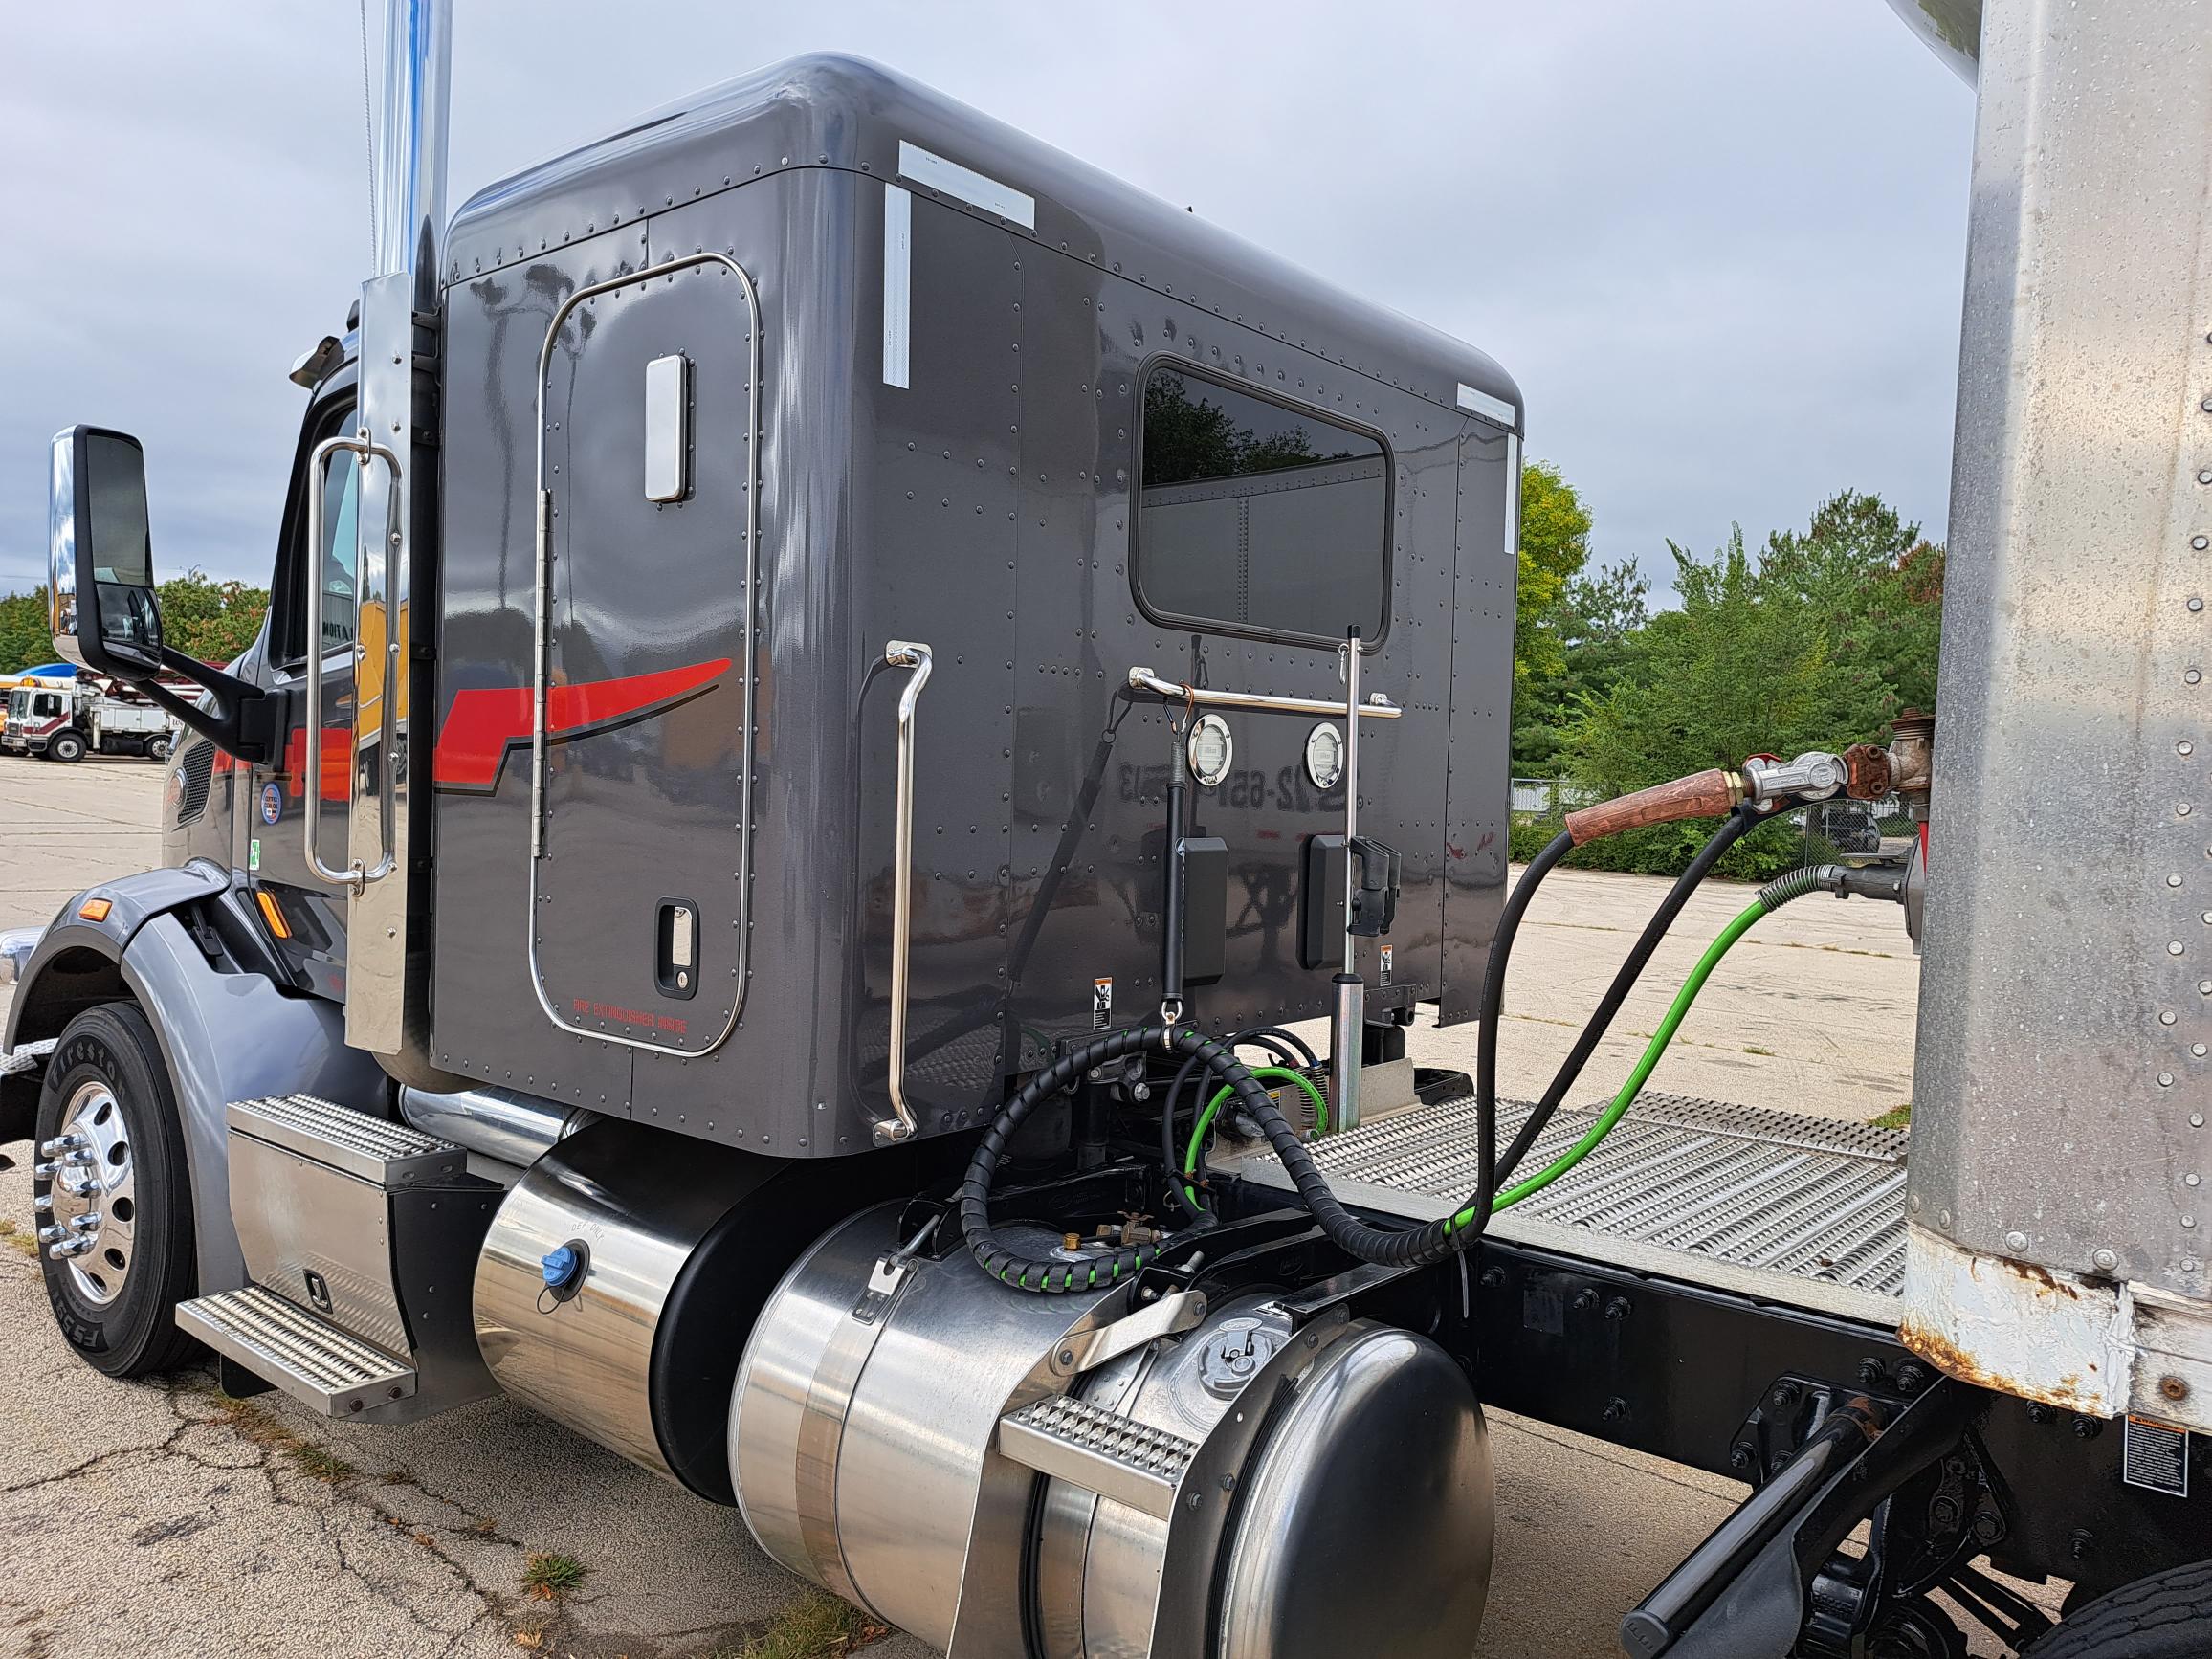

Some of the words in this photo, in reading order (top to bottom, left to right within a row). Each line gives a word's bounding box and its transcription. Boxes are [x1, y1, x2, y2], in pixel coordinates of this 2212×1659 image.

[573, 998, 590, 1015] FIRE
[593, 1002, 655, 1027] EXTINGUISHER
[657, 1016, 689, 1035] INSIDE
[571, 1221, 587, 1232] DEF
[589, 1223, 605, 1242] ONLY
